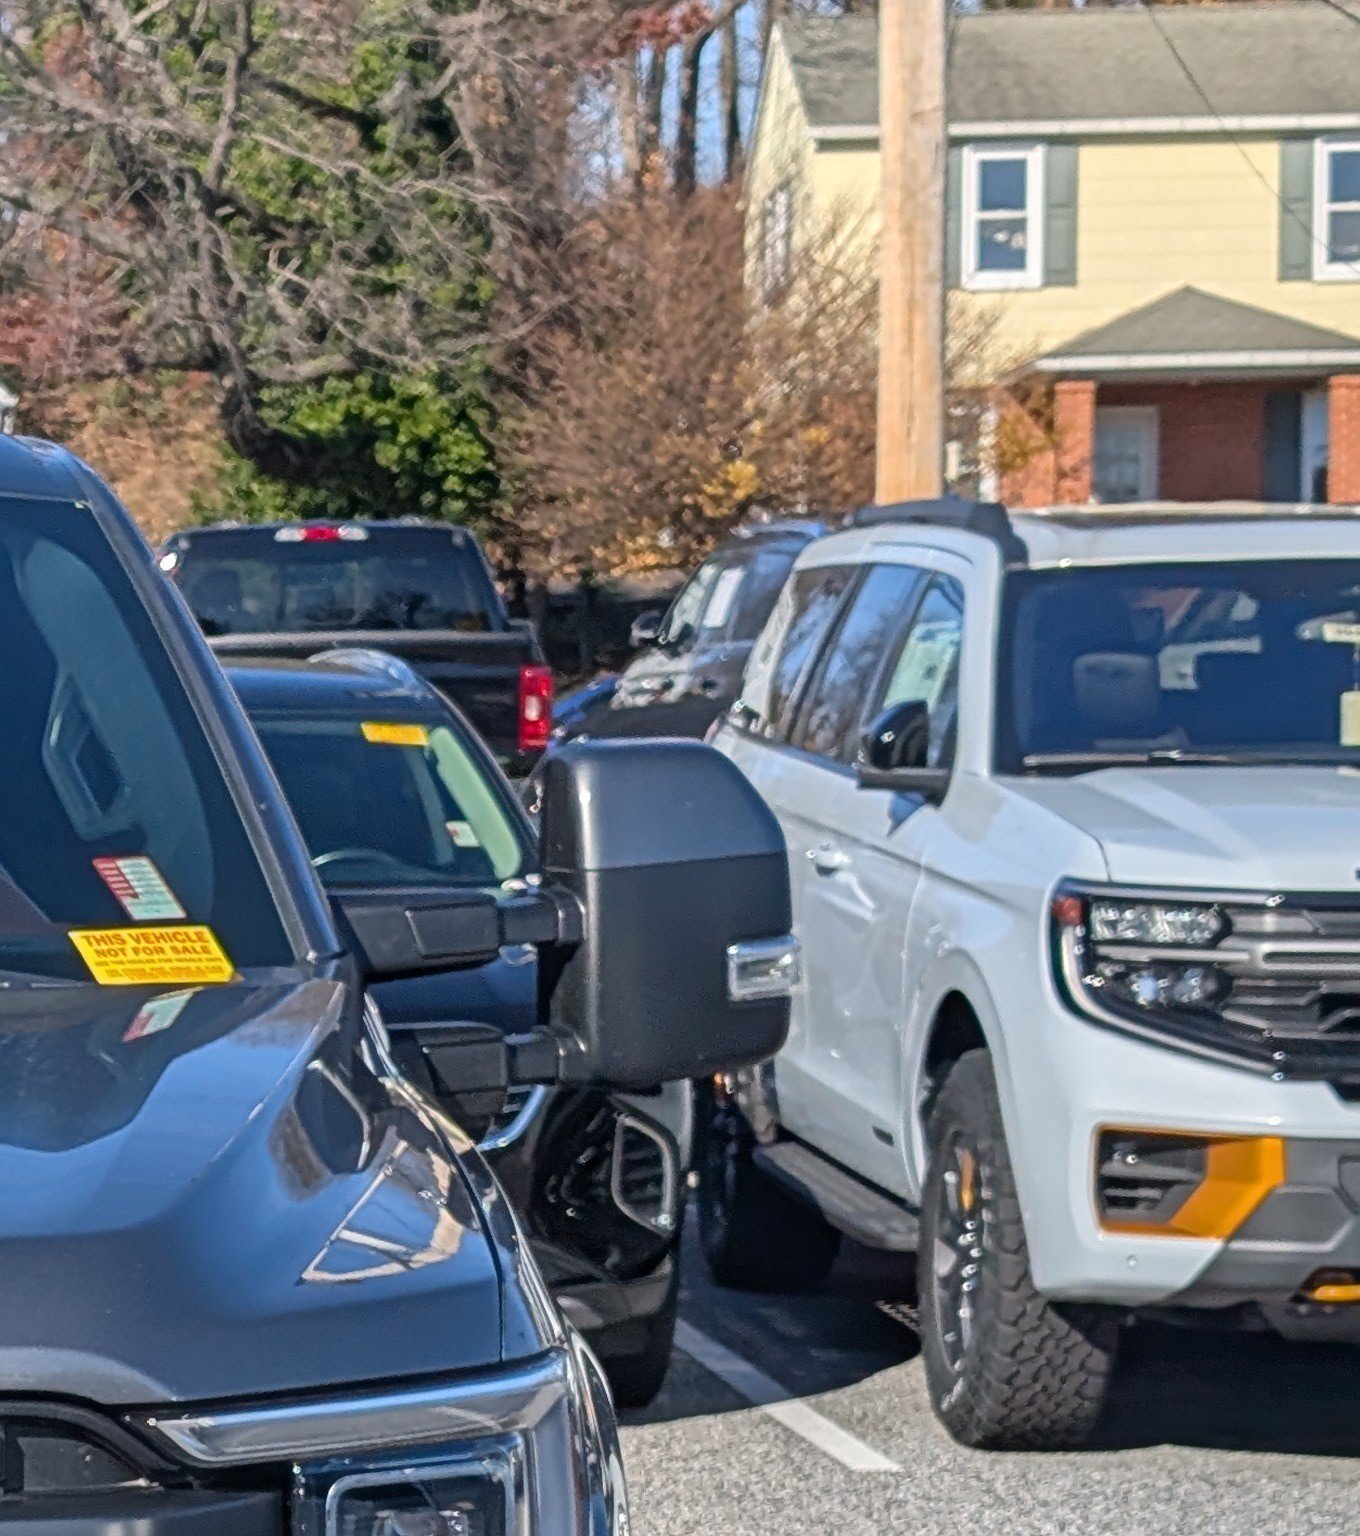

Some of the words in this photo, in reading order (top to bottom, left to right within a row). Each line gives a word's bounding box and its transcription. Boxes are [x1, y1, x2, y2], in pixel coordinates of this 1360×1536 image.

[82, 932, 127, 947] THIS
[128, 930, 210, 945] VEHICLE
[93, 947, 128, 958] NOT
[131, 946, 167, 957] FOR
[170, 944, 212, 956] SALE
